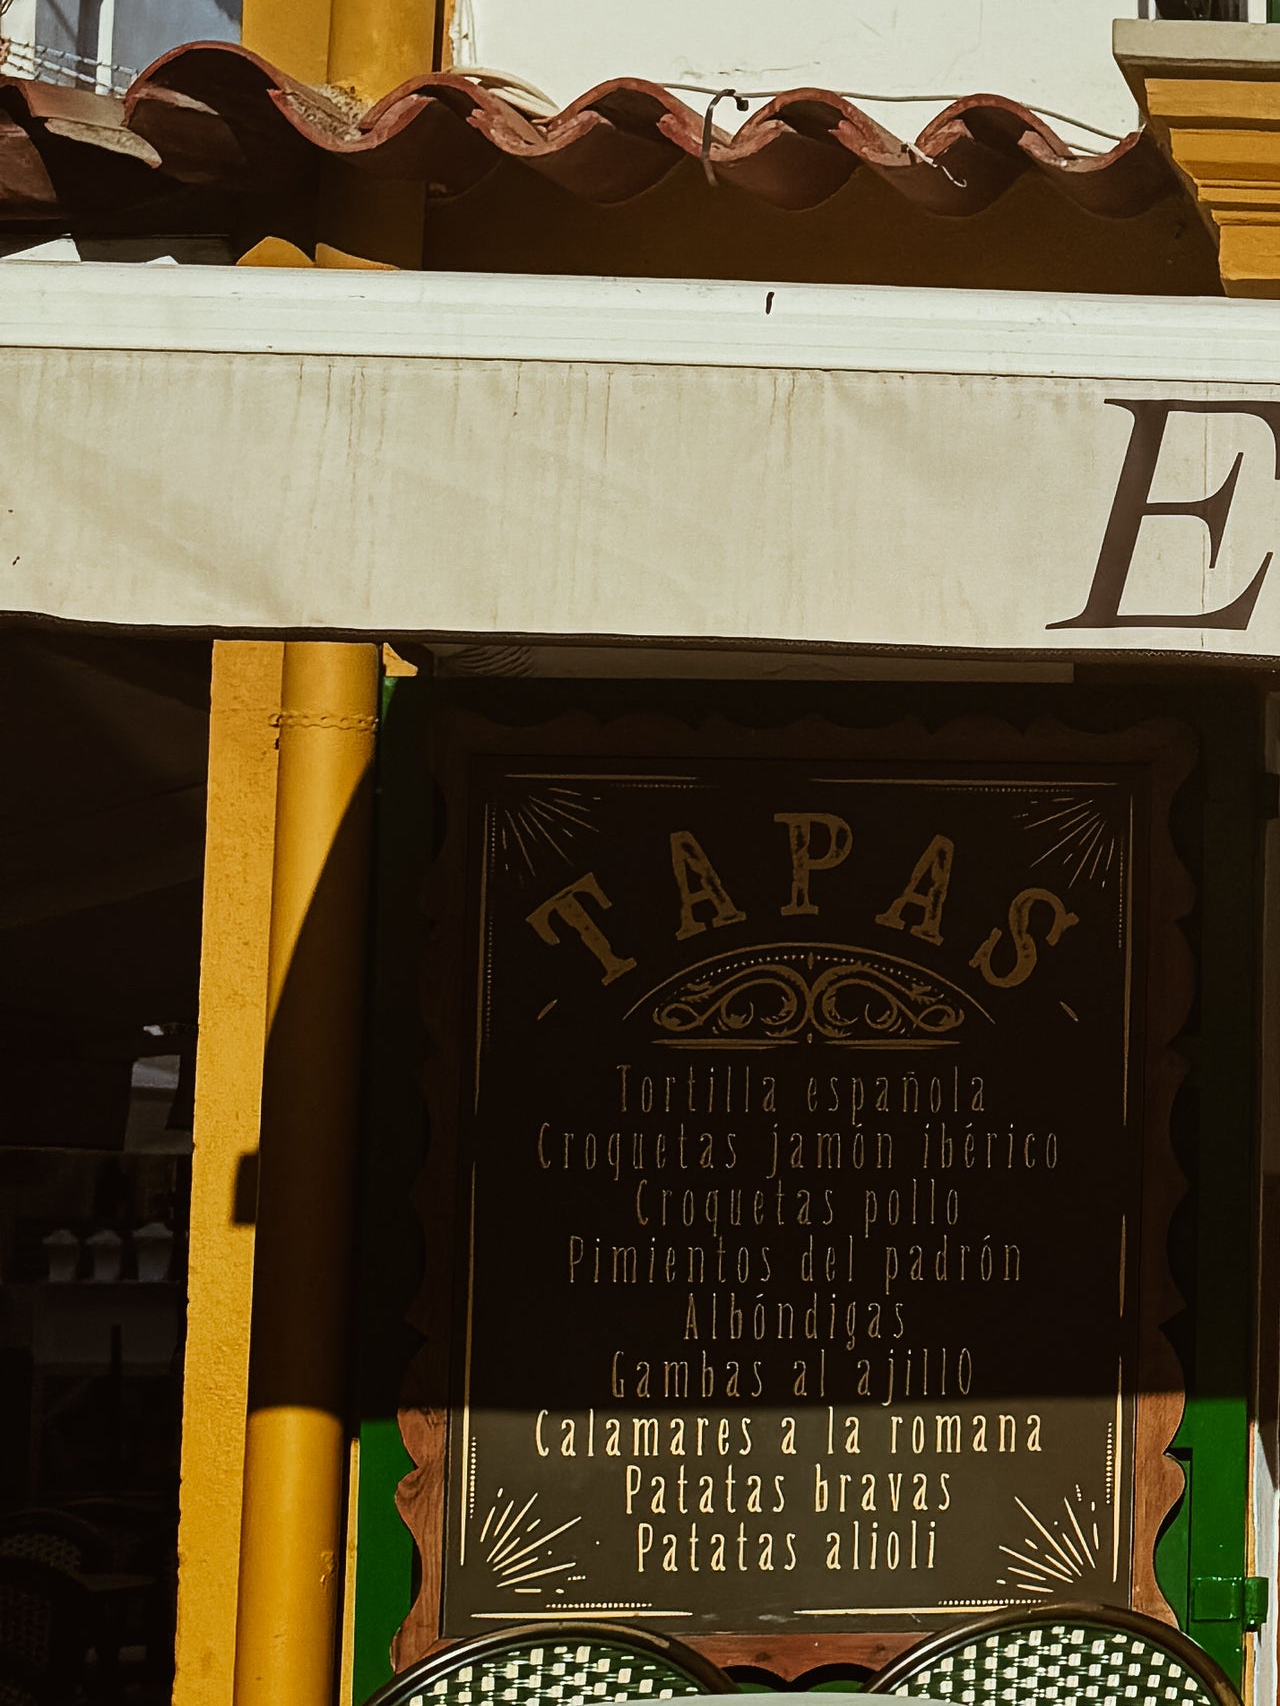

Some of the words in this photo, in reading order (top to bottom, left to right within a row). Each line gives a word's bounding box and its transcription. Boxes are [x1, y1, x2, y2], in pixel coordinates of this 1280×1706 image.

[525, 812, 1080, 990] TAPAS
[617, 1065, 776, 1112] Tortilla
[808, 1066, 984, 1124] española
[538, 1123, 736, 1180] Croquetas
[766, 1122, 892, 1181] jamón
[924, 1123, 1057, 1168] ibérico
[637, 1180, 833, 1237] Croquetas
[865, 1180, 958, 1236] pollo
[570, 1236, 770, 1283] Pimientos
[802, 1236, 852, 1281] del
[886, 1236, 1019, 1295] padrón
[684, 1293, 908, 1352] Albóndigas
[612, 1350, 762, 1397] Gambas
[794, 1350, 824, 1396] al
[536, 1409, 751, 1456] Calamares
[782, 1418, 796, 1454] a
[828, 1409, 860, 1454] la
[891, 1415, 1041, 1453] romana
[627, 1465, 787, 1514] Patatas
[816, 1464, 949, 1512] bravas
[638, 1523, 796, 1572] Patatas
[827, 1521, 935, 1569] alioli
